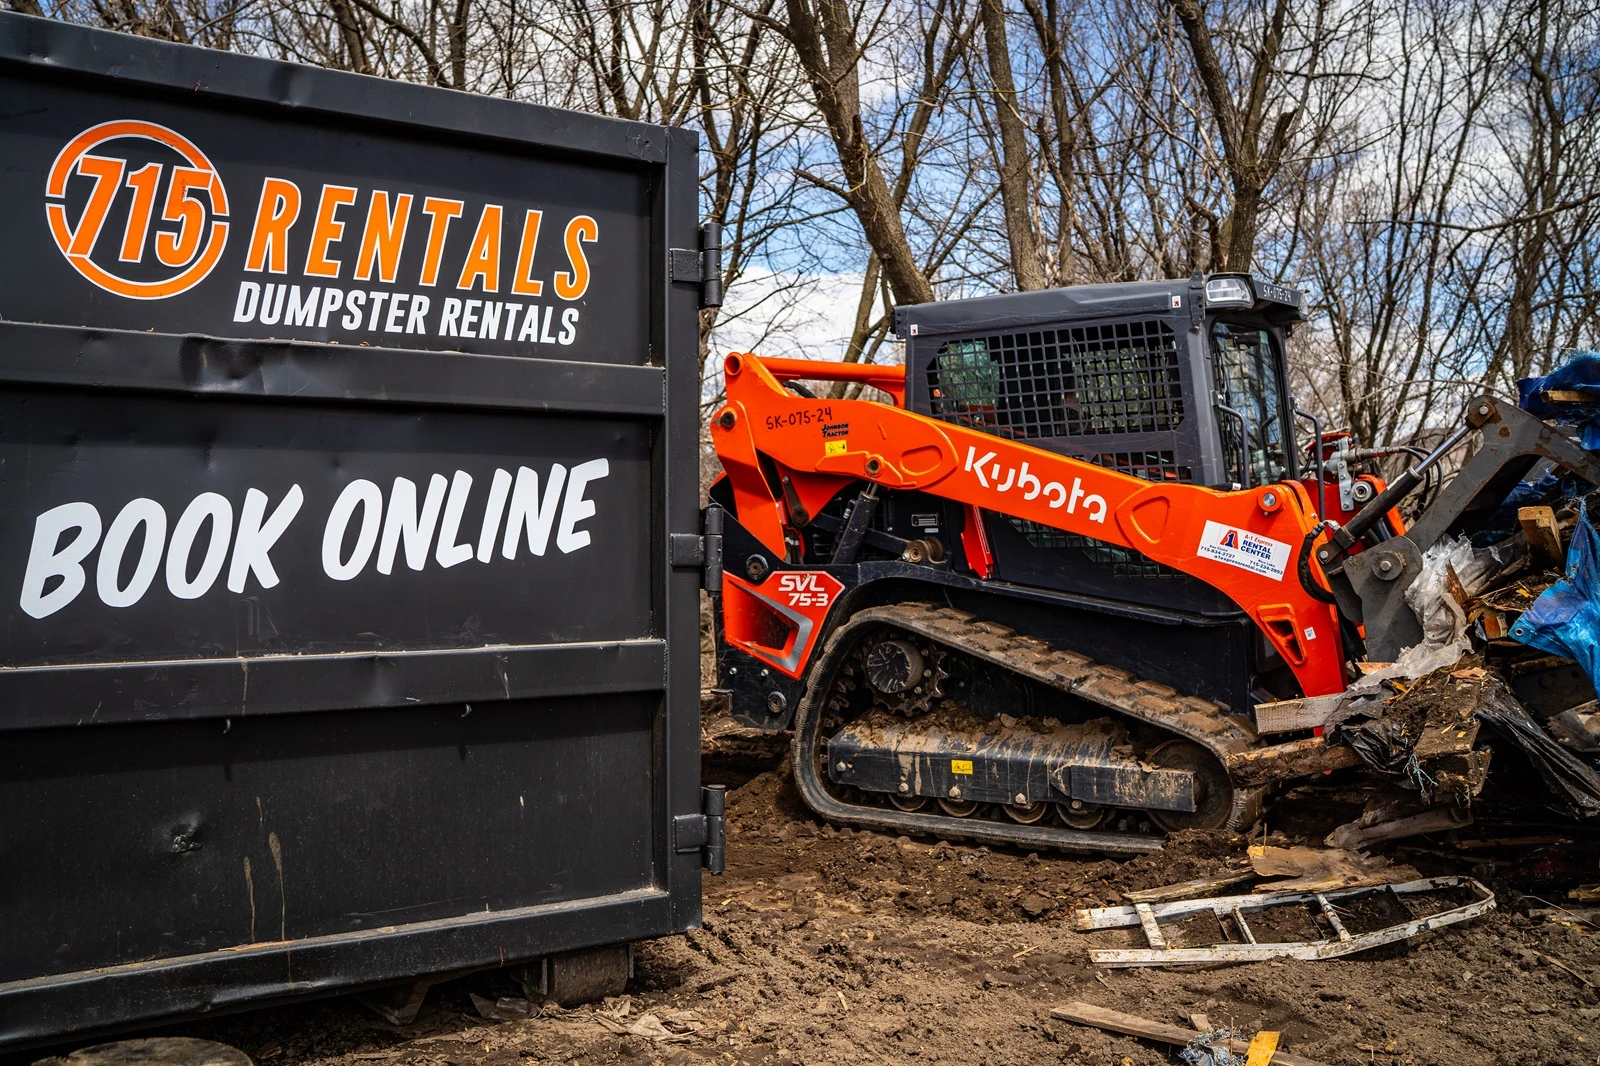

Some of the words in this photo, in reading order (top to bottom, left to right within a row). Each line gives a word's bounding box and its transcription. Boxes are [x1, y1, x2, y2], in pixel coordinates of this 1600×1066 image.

[67, 155, 213, 267] 715
[244, 177, 598, 301] RENTALS
[233, 281, 430, 336] DUMPSTER
[438, 300, 580, 346] RENTALS
[766, 407, 832, 430] SK-075-24
[822, 423, 849, 431] JOHNSON
[822, 430, 849, 438] TRACTOR
[964, 445, 1107, 524] Kubota
[20, 483, 304, 620] BOOK
[322, 458, 609, 581] ONLINE
[1242, 540, 1272, 554] RENTAL
[1254, 537, 1273, 547] Express
[1240, 545, 1271, 560] CENTER
[1214, 555, 1267, 574] a1expressrental.com
[778, 575, 825, 591] SVL
[788, 593, 829, 606] 75-3
